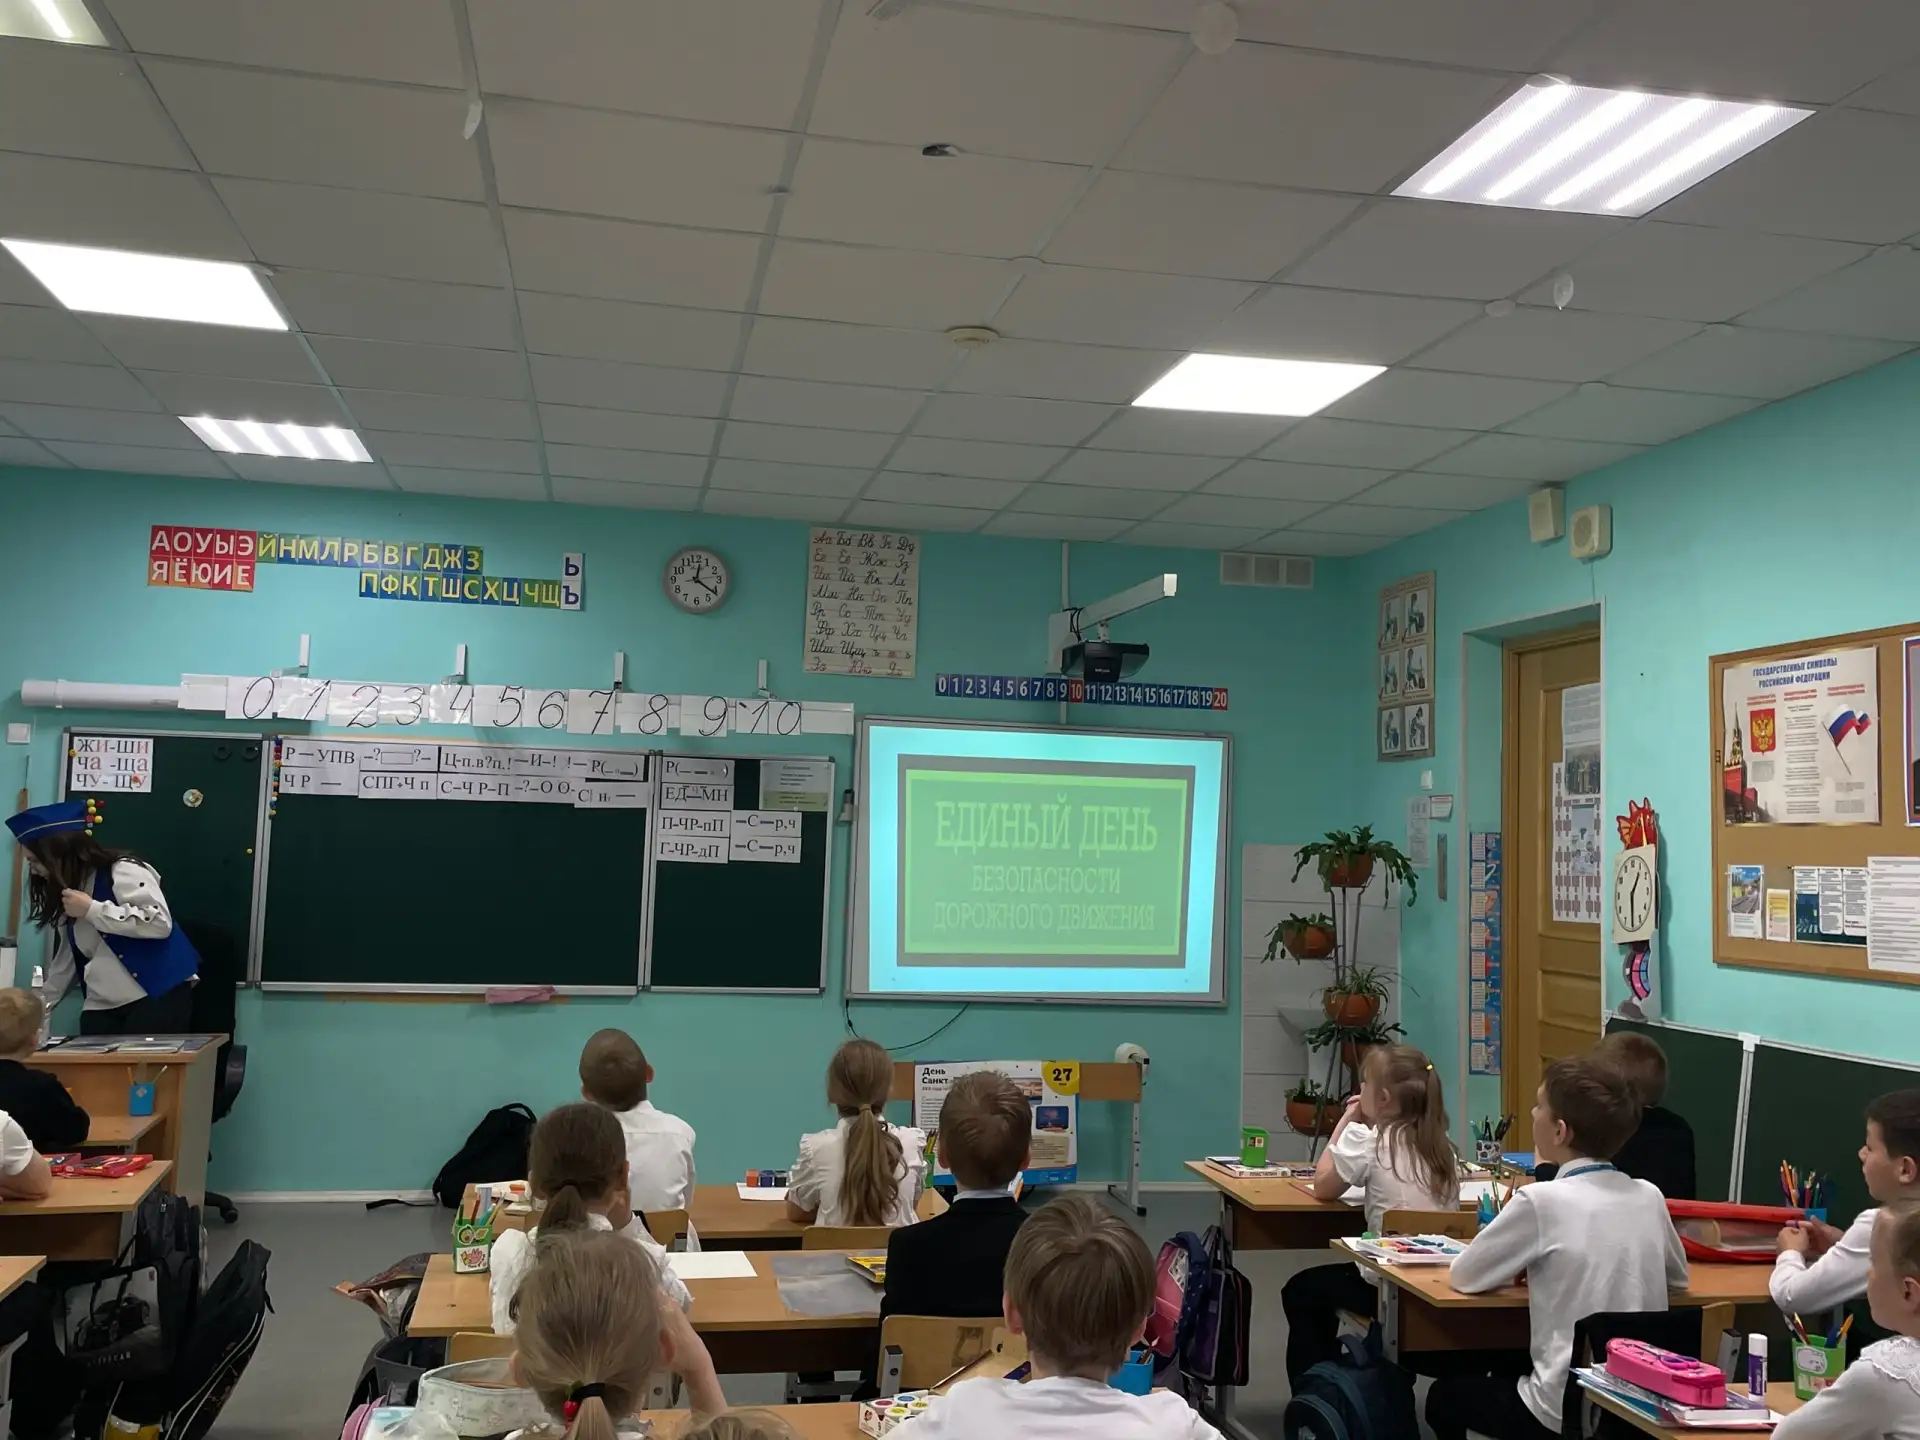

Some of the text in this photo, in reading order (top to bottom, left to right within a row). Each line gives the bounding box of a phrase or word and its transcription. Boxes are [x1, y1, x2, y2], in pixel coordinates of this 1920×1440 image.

[682, 558, 690, 566] 11
[691, 555, 701, 563] 12
[705, 558, 709, 566] 1
[674, 567, 684, 575] 10
[712, 566, 717, 575] 2
[671, 576, 676, 584] 9
[716, 576, 721, 584] 3
[675, 585, 680, 593] 8
[694, 597, 699, 605] 6
[1807, 658, 1837, 669] СИМВОЛЫ
[1759, 672, 1830, 688] РОССИЙСКОЙ ФЕДЕРАЦИИ
[938, 680, 1226, 706] 0 1 2 3 4 5 6 7 8 9 10 11 12 13 14 15 16 17 18 19 20
[243, 676, 801, 736] 0 1 2 3 4 5 6 7 8 9 10
[935, 792, 1158, 859] ЕДИНЫЙ ДЕНЬ
[971, 865, 1121, 894] БЕЗОПАСНОСТИ
[933, 901, 1155, 934] ДОРОЖНОГО ДВИЖЕНИЯ
[922, 1068, 946, 1076] День
[1052, 1068, 1072, 1081] 27
